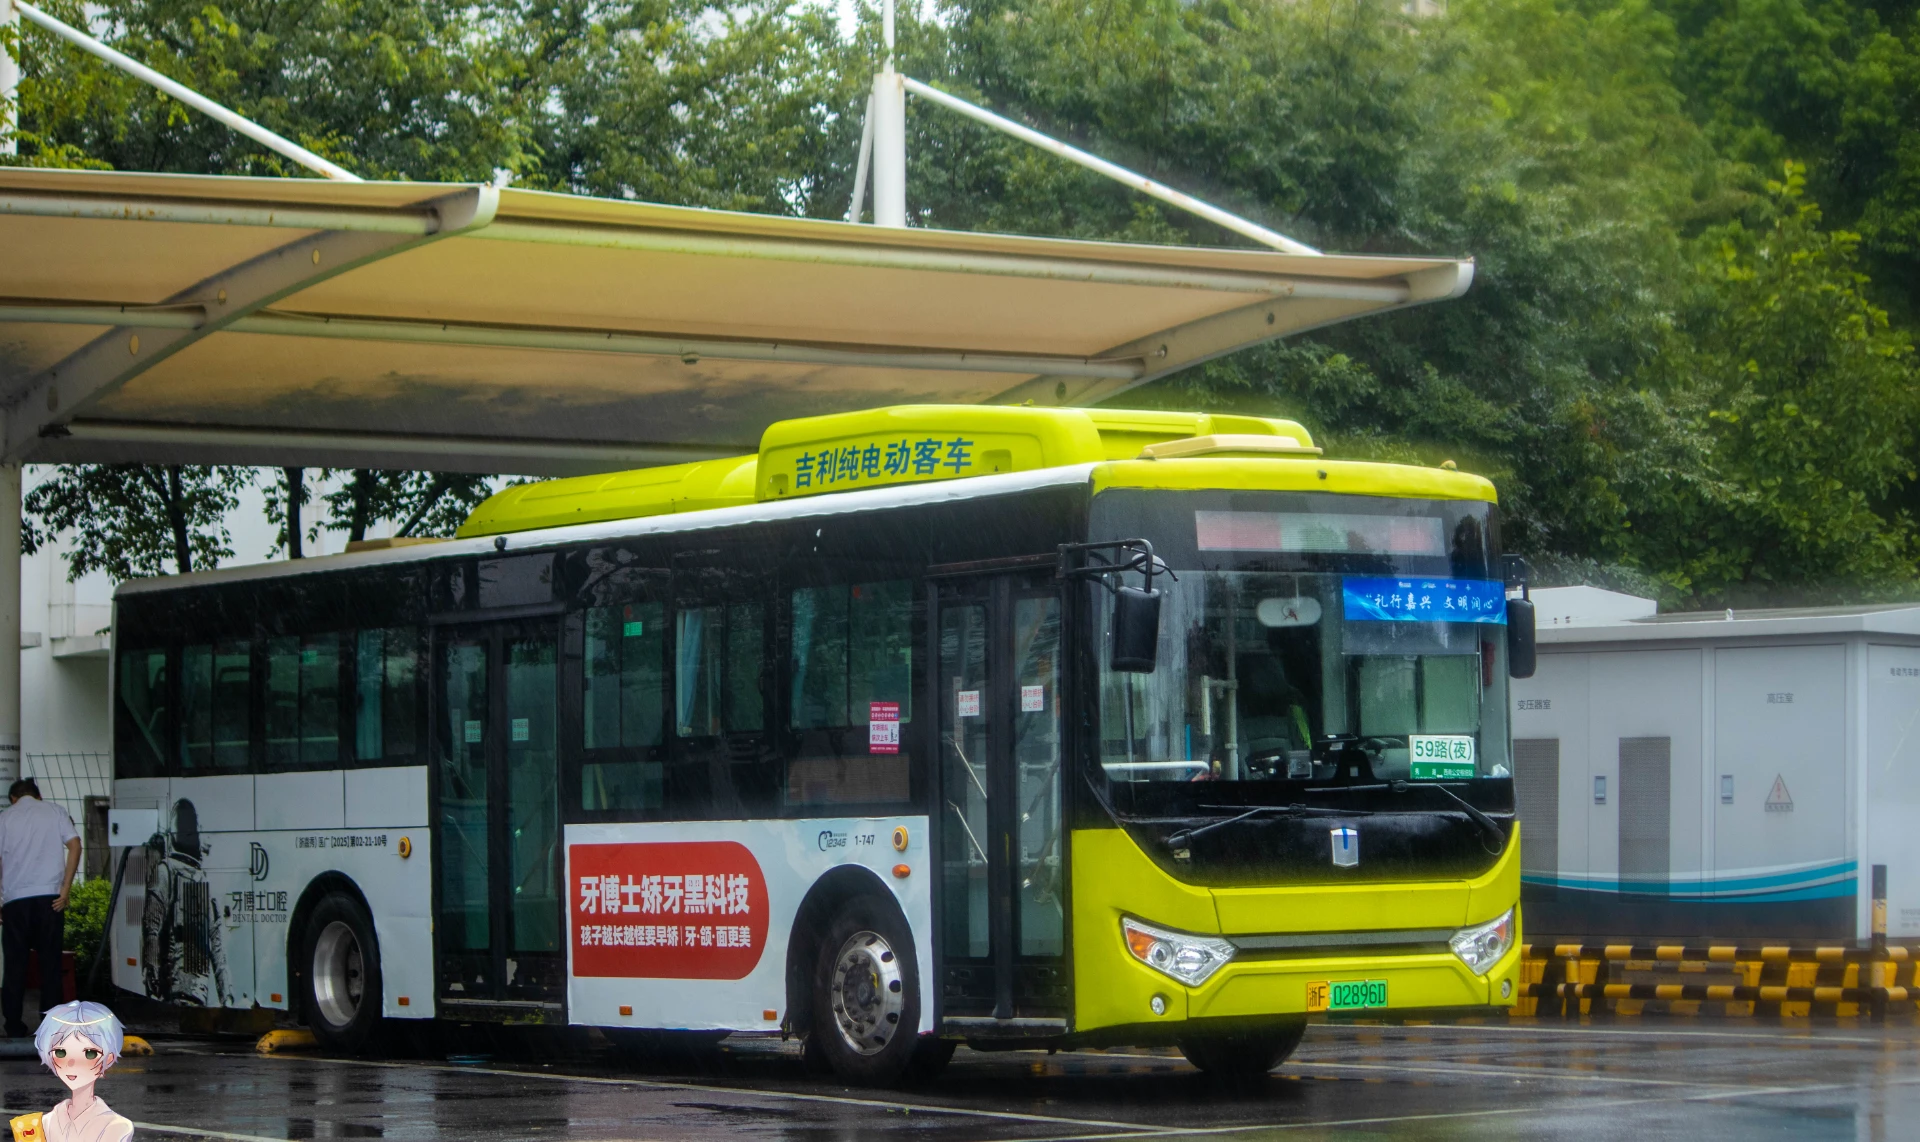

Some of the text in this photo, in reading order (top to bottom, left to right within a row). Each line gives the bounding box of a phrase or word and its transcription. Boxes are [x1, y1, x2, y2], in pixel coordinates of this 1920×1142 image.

[795, 437, 974, 488] 吉利纯电动客车
[1517, 699, 1551, 710] 变压器室
[1766, 692, 1794, 704] 高压室
[1415, 740, 1472, 760] 59路(夜)
[826, 838, 847, 848] 12345
[854, 834, 875, 846] 1-747
[232, 890, 287, 911] 牙博士口腔
[579, 874, 750, 915] 牙博士矫牙黑科技
[232, 913, 287, 923] DENTAL DOCTOR
[580, 924, 679, 947] 孩子越长越怪要早矫
[1308, 983, 1386, 1007] 浙F 02896D
